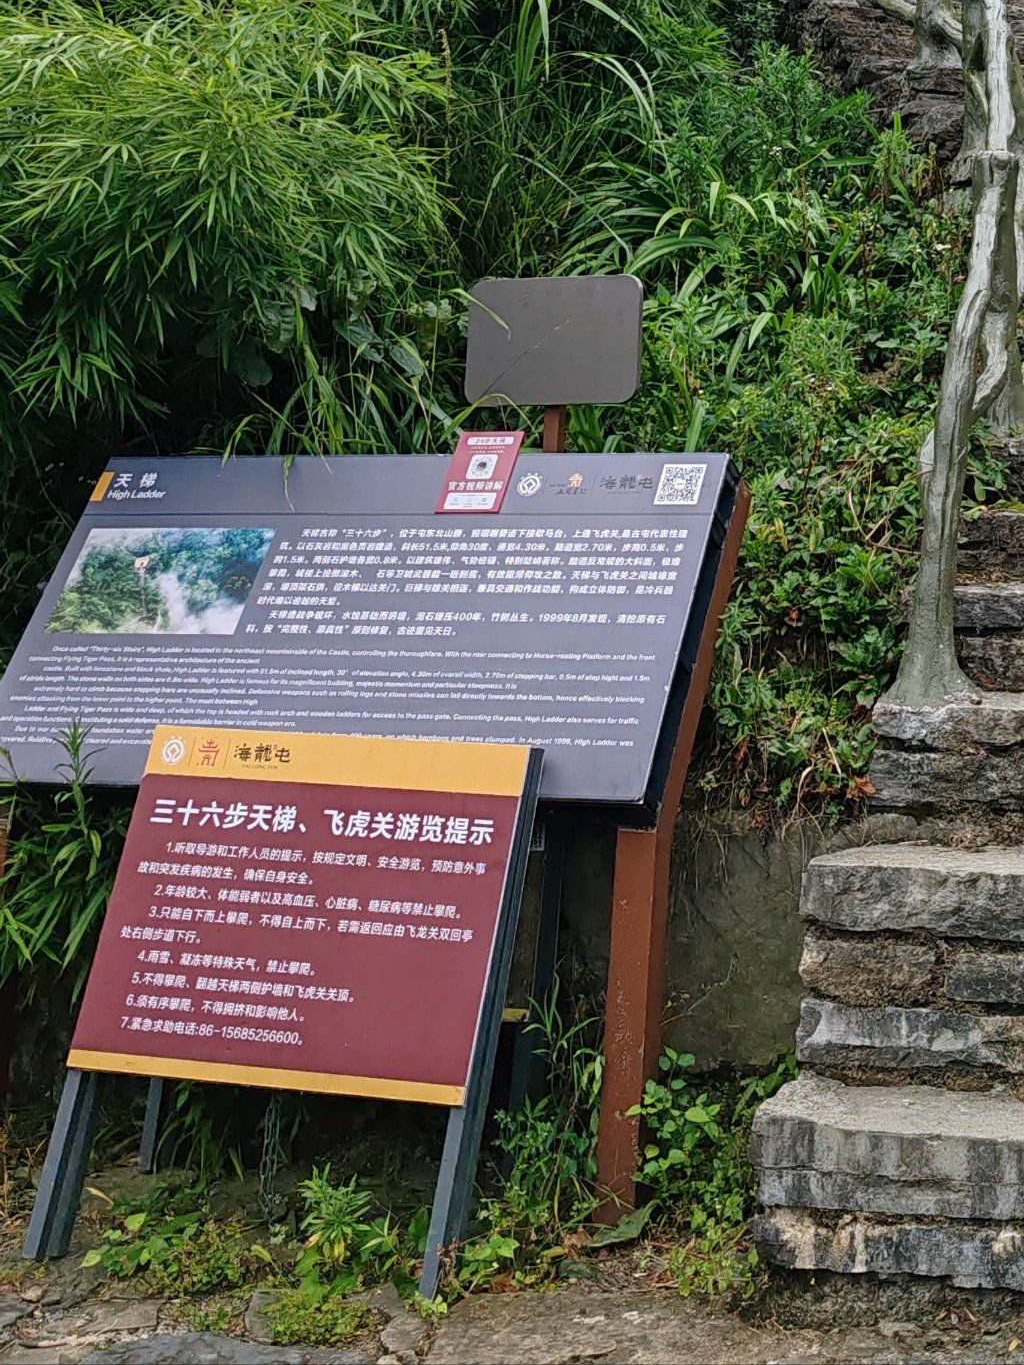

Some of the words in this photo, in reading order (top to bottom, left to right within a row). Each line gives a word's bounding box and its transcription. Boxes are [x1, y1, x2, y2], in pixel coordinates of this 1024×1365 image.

[114, 472, 158, 488] 天梯
[448, 480, 503, 491] 官方视频讲解
[107, 489, 131, 500] High
[131, 489, 167, 499] Ladder
[150, 798, 495, 846] 三十六步天梯、飞虎关游览提示
